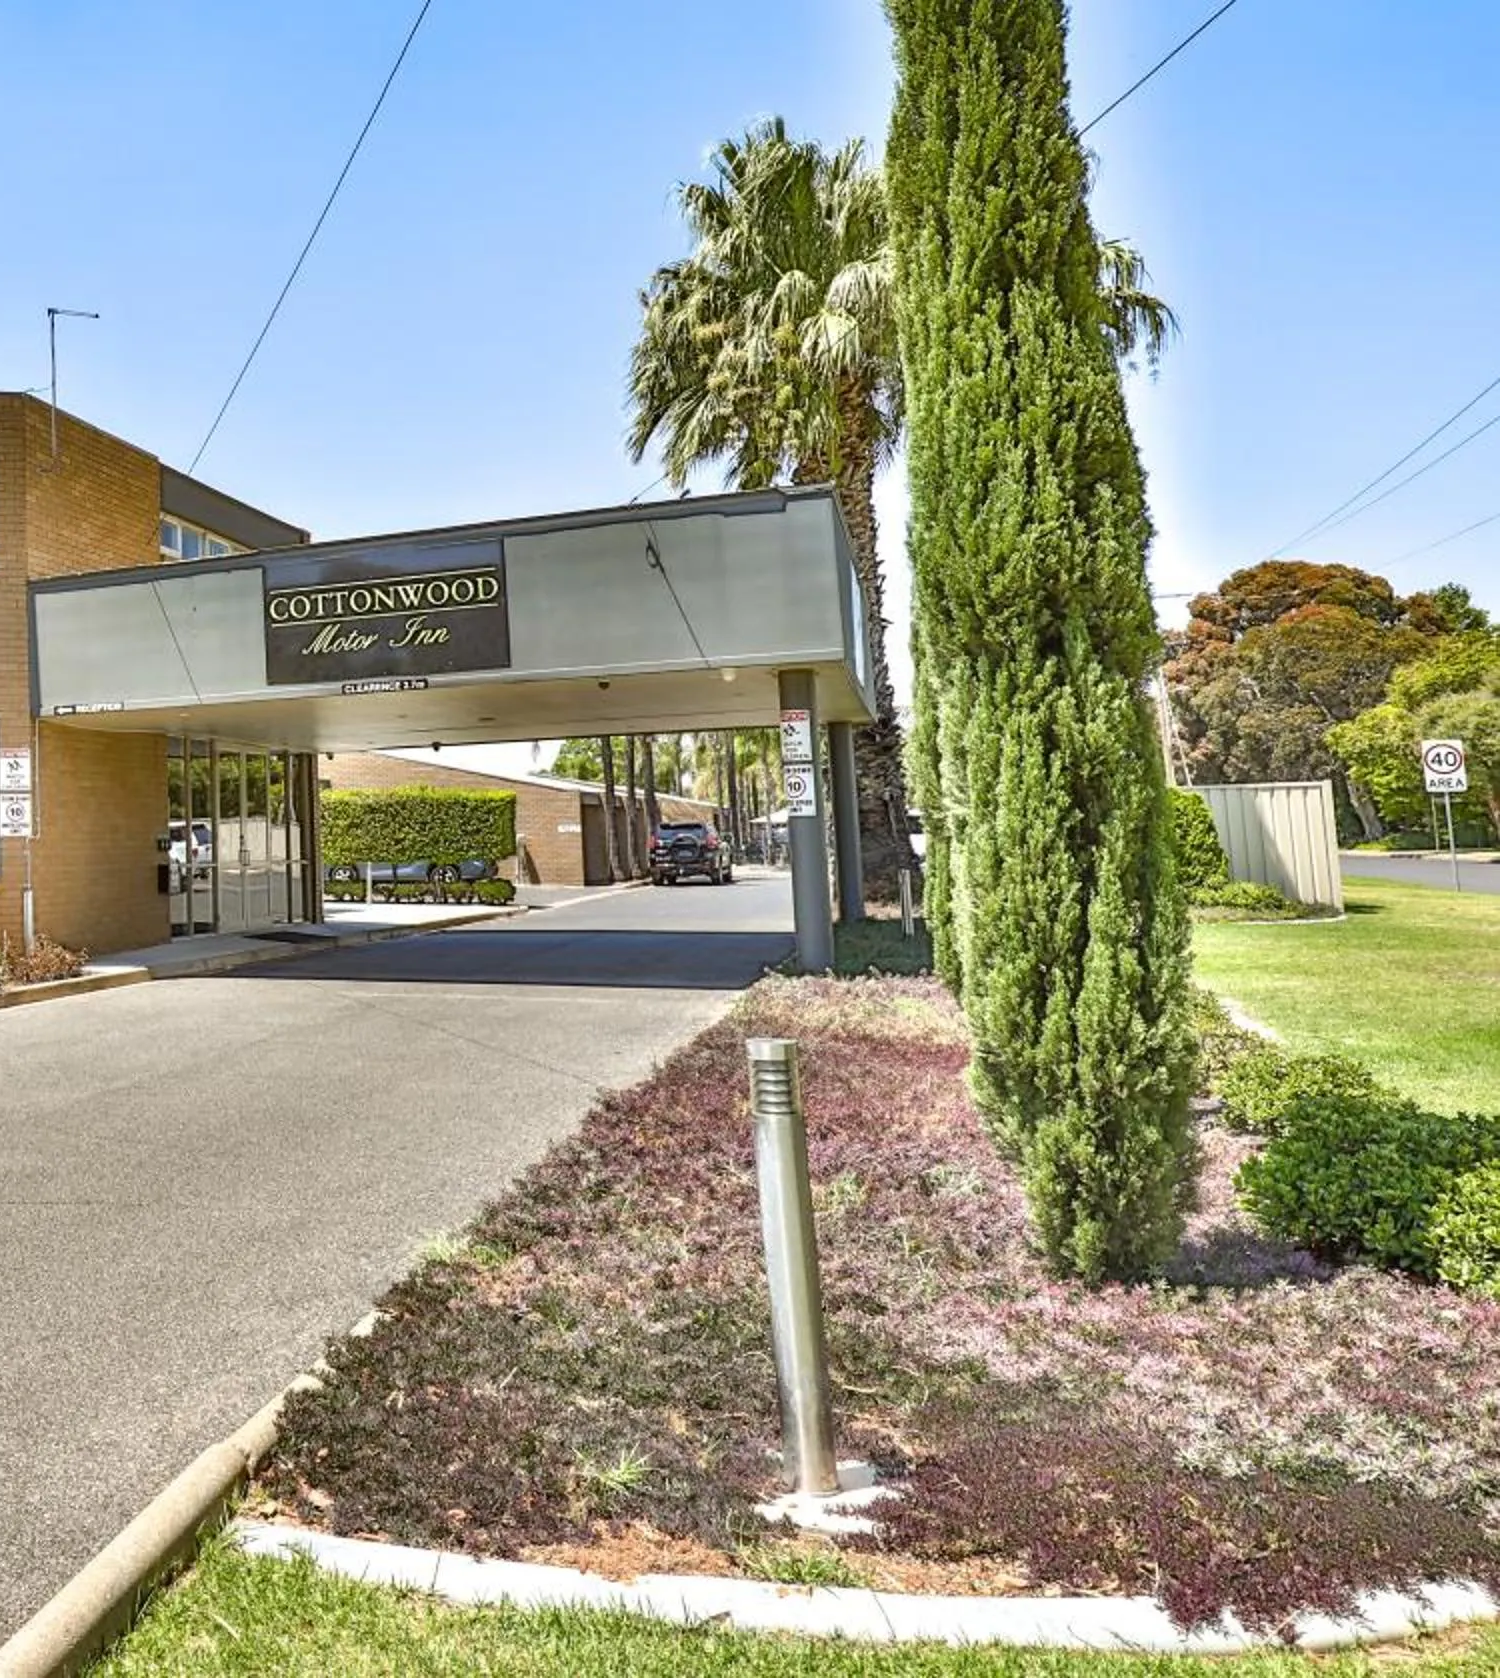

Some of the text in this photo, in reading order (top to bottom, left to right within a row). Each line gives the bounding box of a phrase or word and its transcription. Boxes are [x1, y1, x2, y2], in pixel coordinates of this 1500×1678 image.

[269, 577, 499, 621] COTTONWOOD
[301, 615, 449, 655] Motor Inn
[1430, 751, 1458, 767] 40
[787, 781, 802, 792] 10
[1429, 779, 1465, 788] AREA
[10, 807, 23, 818] 10
